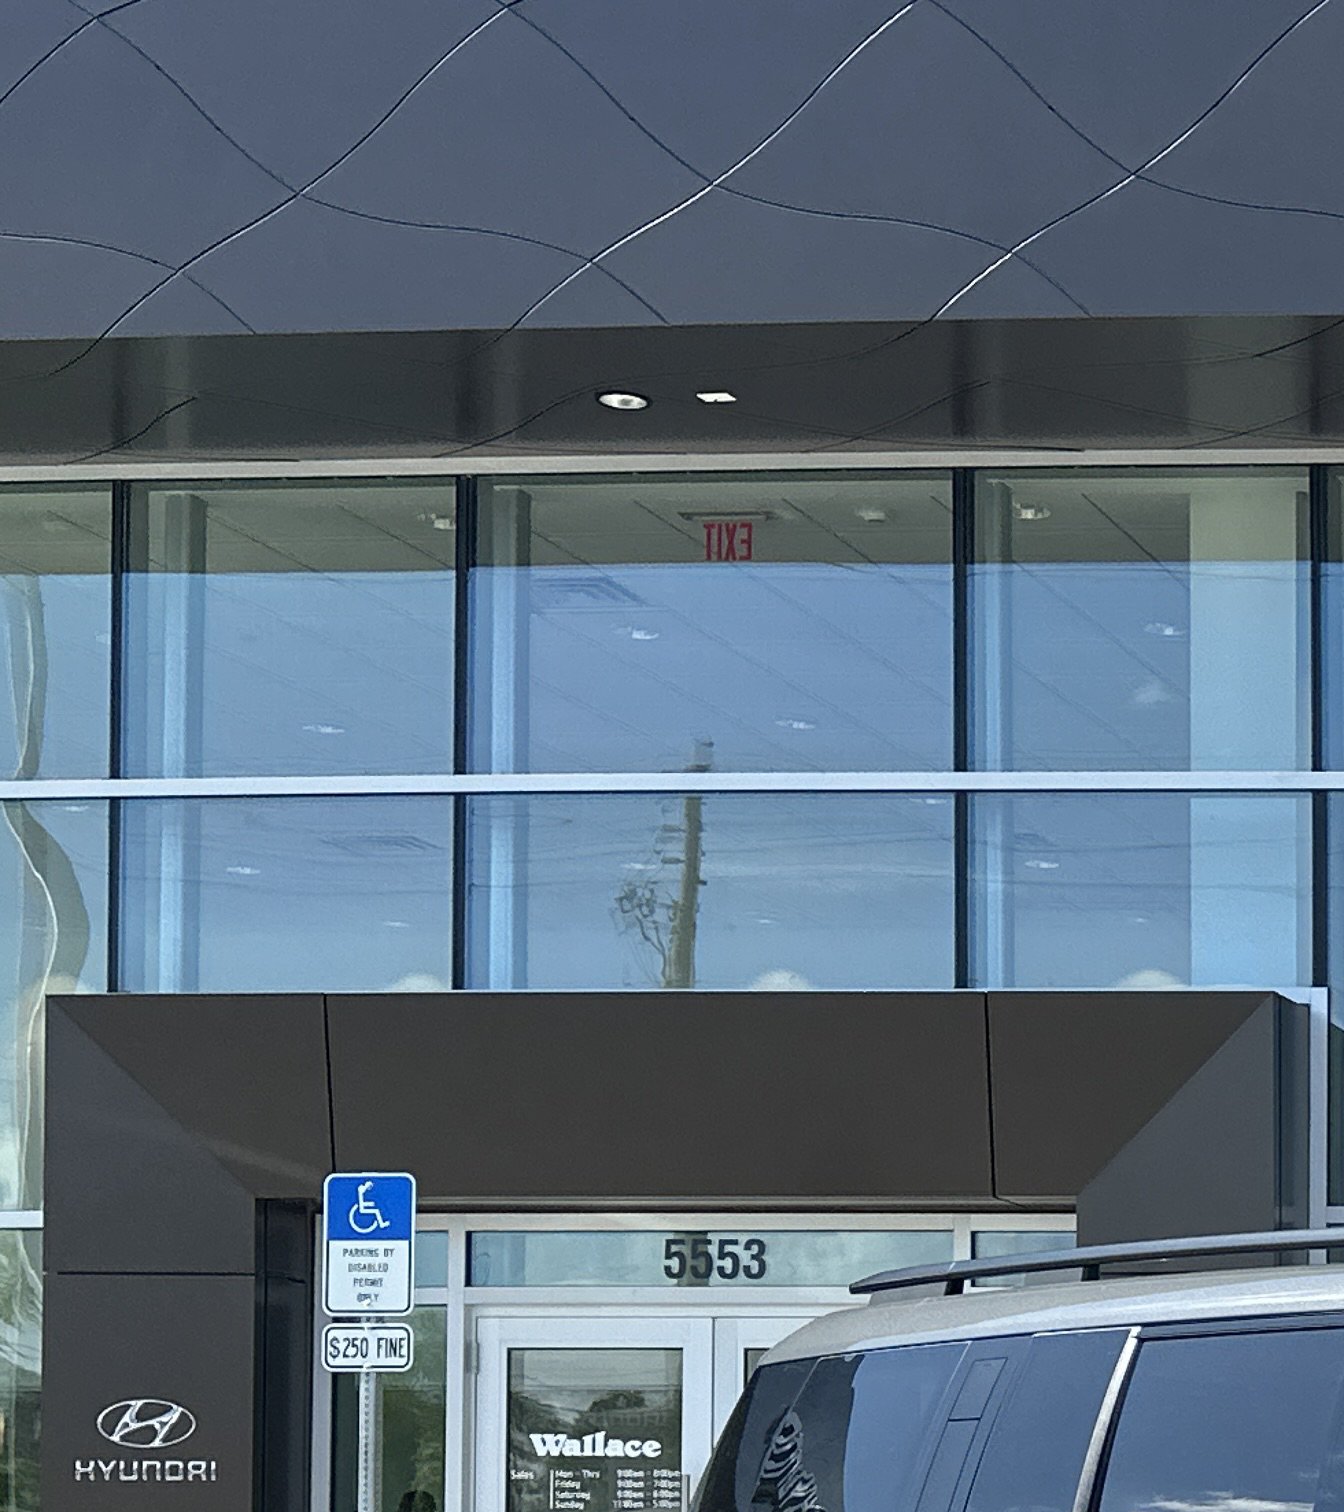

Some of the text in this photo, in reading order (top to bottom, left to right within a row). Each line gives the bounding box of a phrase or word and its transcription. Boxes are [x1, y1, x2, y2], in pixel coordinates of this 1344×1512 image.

[342, 1248, 395, 1258] PARKING BY
[663, 1238, 767, 1280] 5553
[328, 1337, 407, 1361] $250 FINE
[529, 1431, 662, 1458] Wallace
[74, 1459, 217, 1482] HYUNDAI
